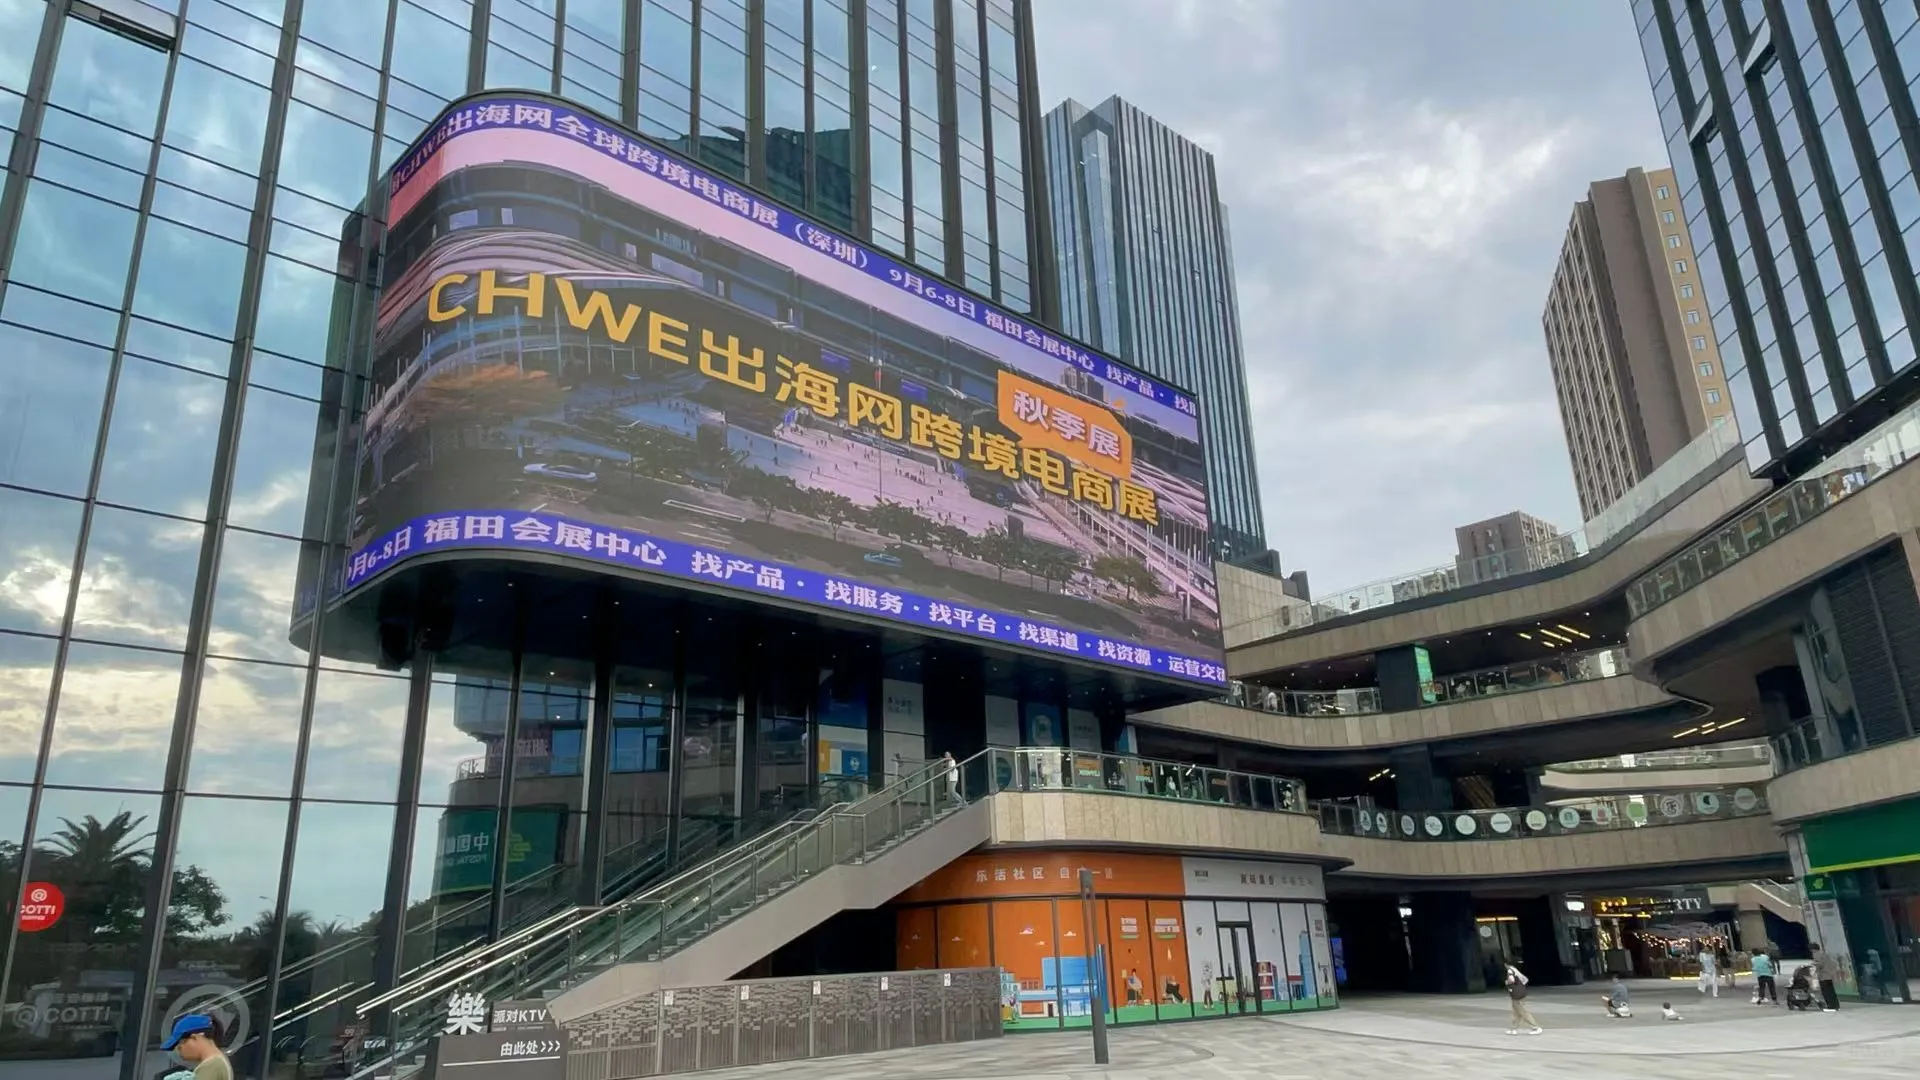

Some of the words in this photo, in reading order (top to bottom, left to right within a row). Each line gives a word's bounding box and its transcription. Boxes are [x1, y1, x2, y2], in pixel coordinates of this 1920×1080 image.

[889, 269, 976, 318] 9月6-8日
[985, 309, 1095, 372] 福田会展中心
[428, 269, 1158, 526] CHWE出海网跨境电商展
[1013, 389, 1121, 461] 秋季展
[424, 515, 667, 566] 福田会展中心
[976, 866, 1045, 883] 乐活社区
[446, 991, 485, 1036] 樂
[493, 1008, 547, 1024] 派对KTV
[500, 1039, 538, 1057] 由此处
